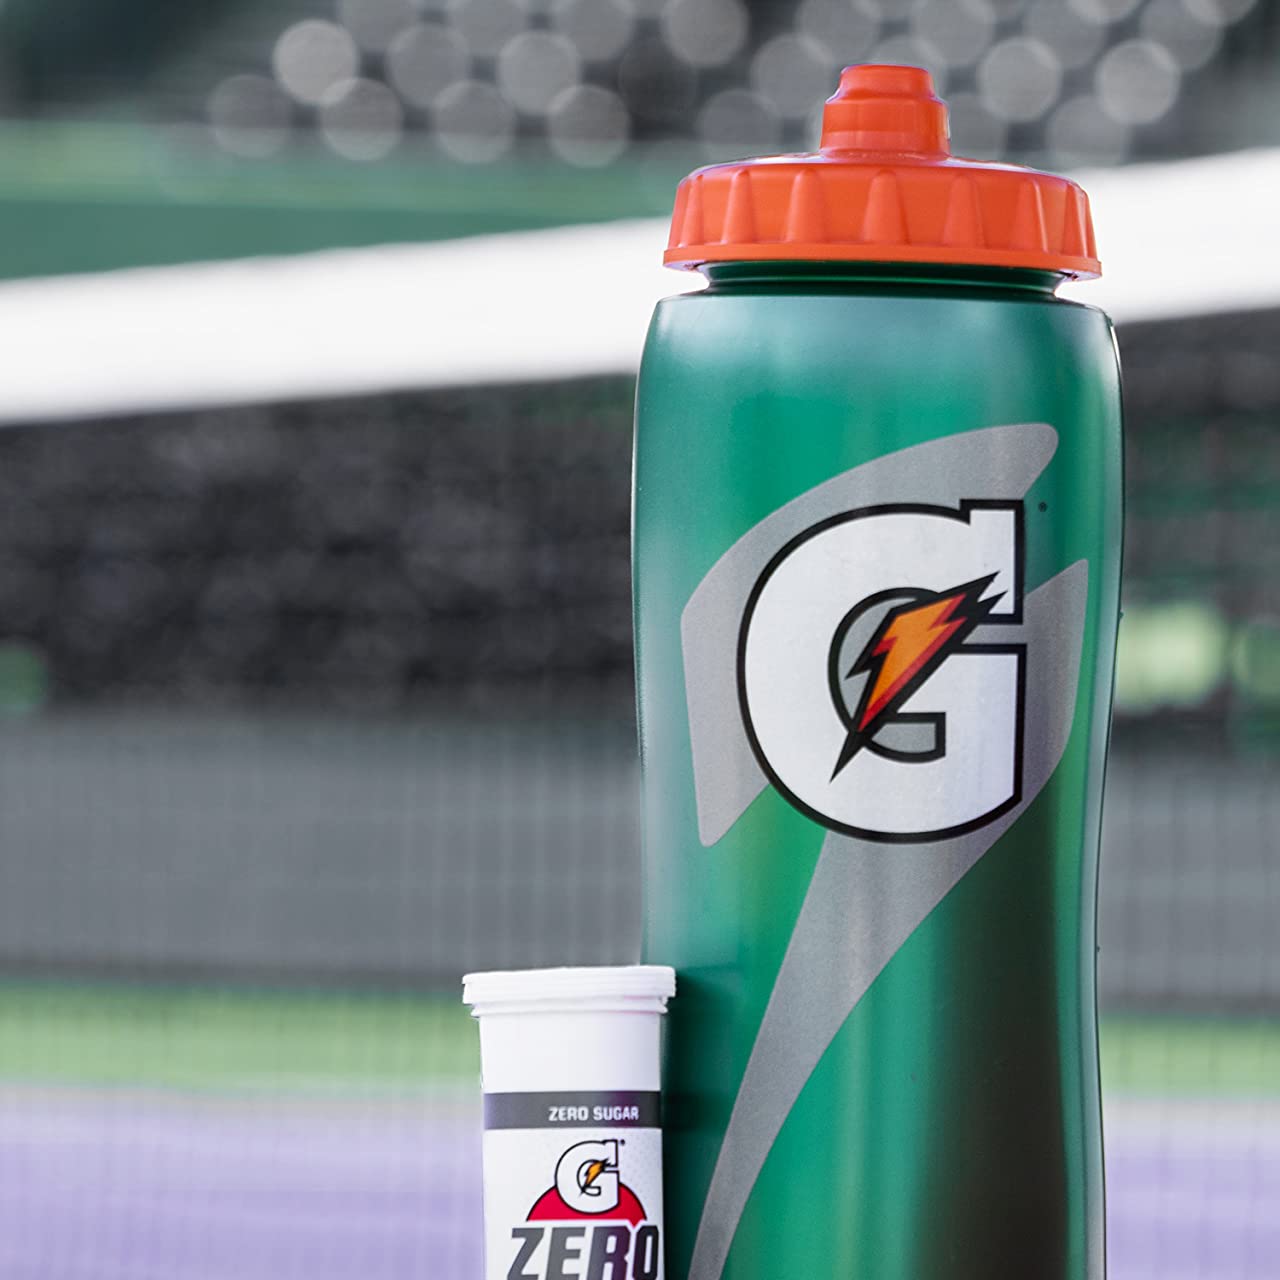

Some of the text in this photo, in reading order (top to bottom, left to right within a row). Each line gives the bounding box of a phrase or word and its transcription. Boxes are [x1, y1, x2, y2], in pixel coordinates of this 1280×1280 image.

[736, 498, 1027, 844] G
[548, 1105, 639, 1122] ZERO SUGAR
[554, 1138, 620, 1214] G
